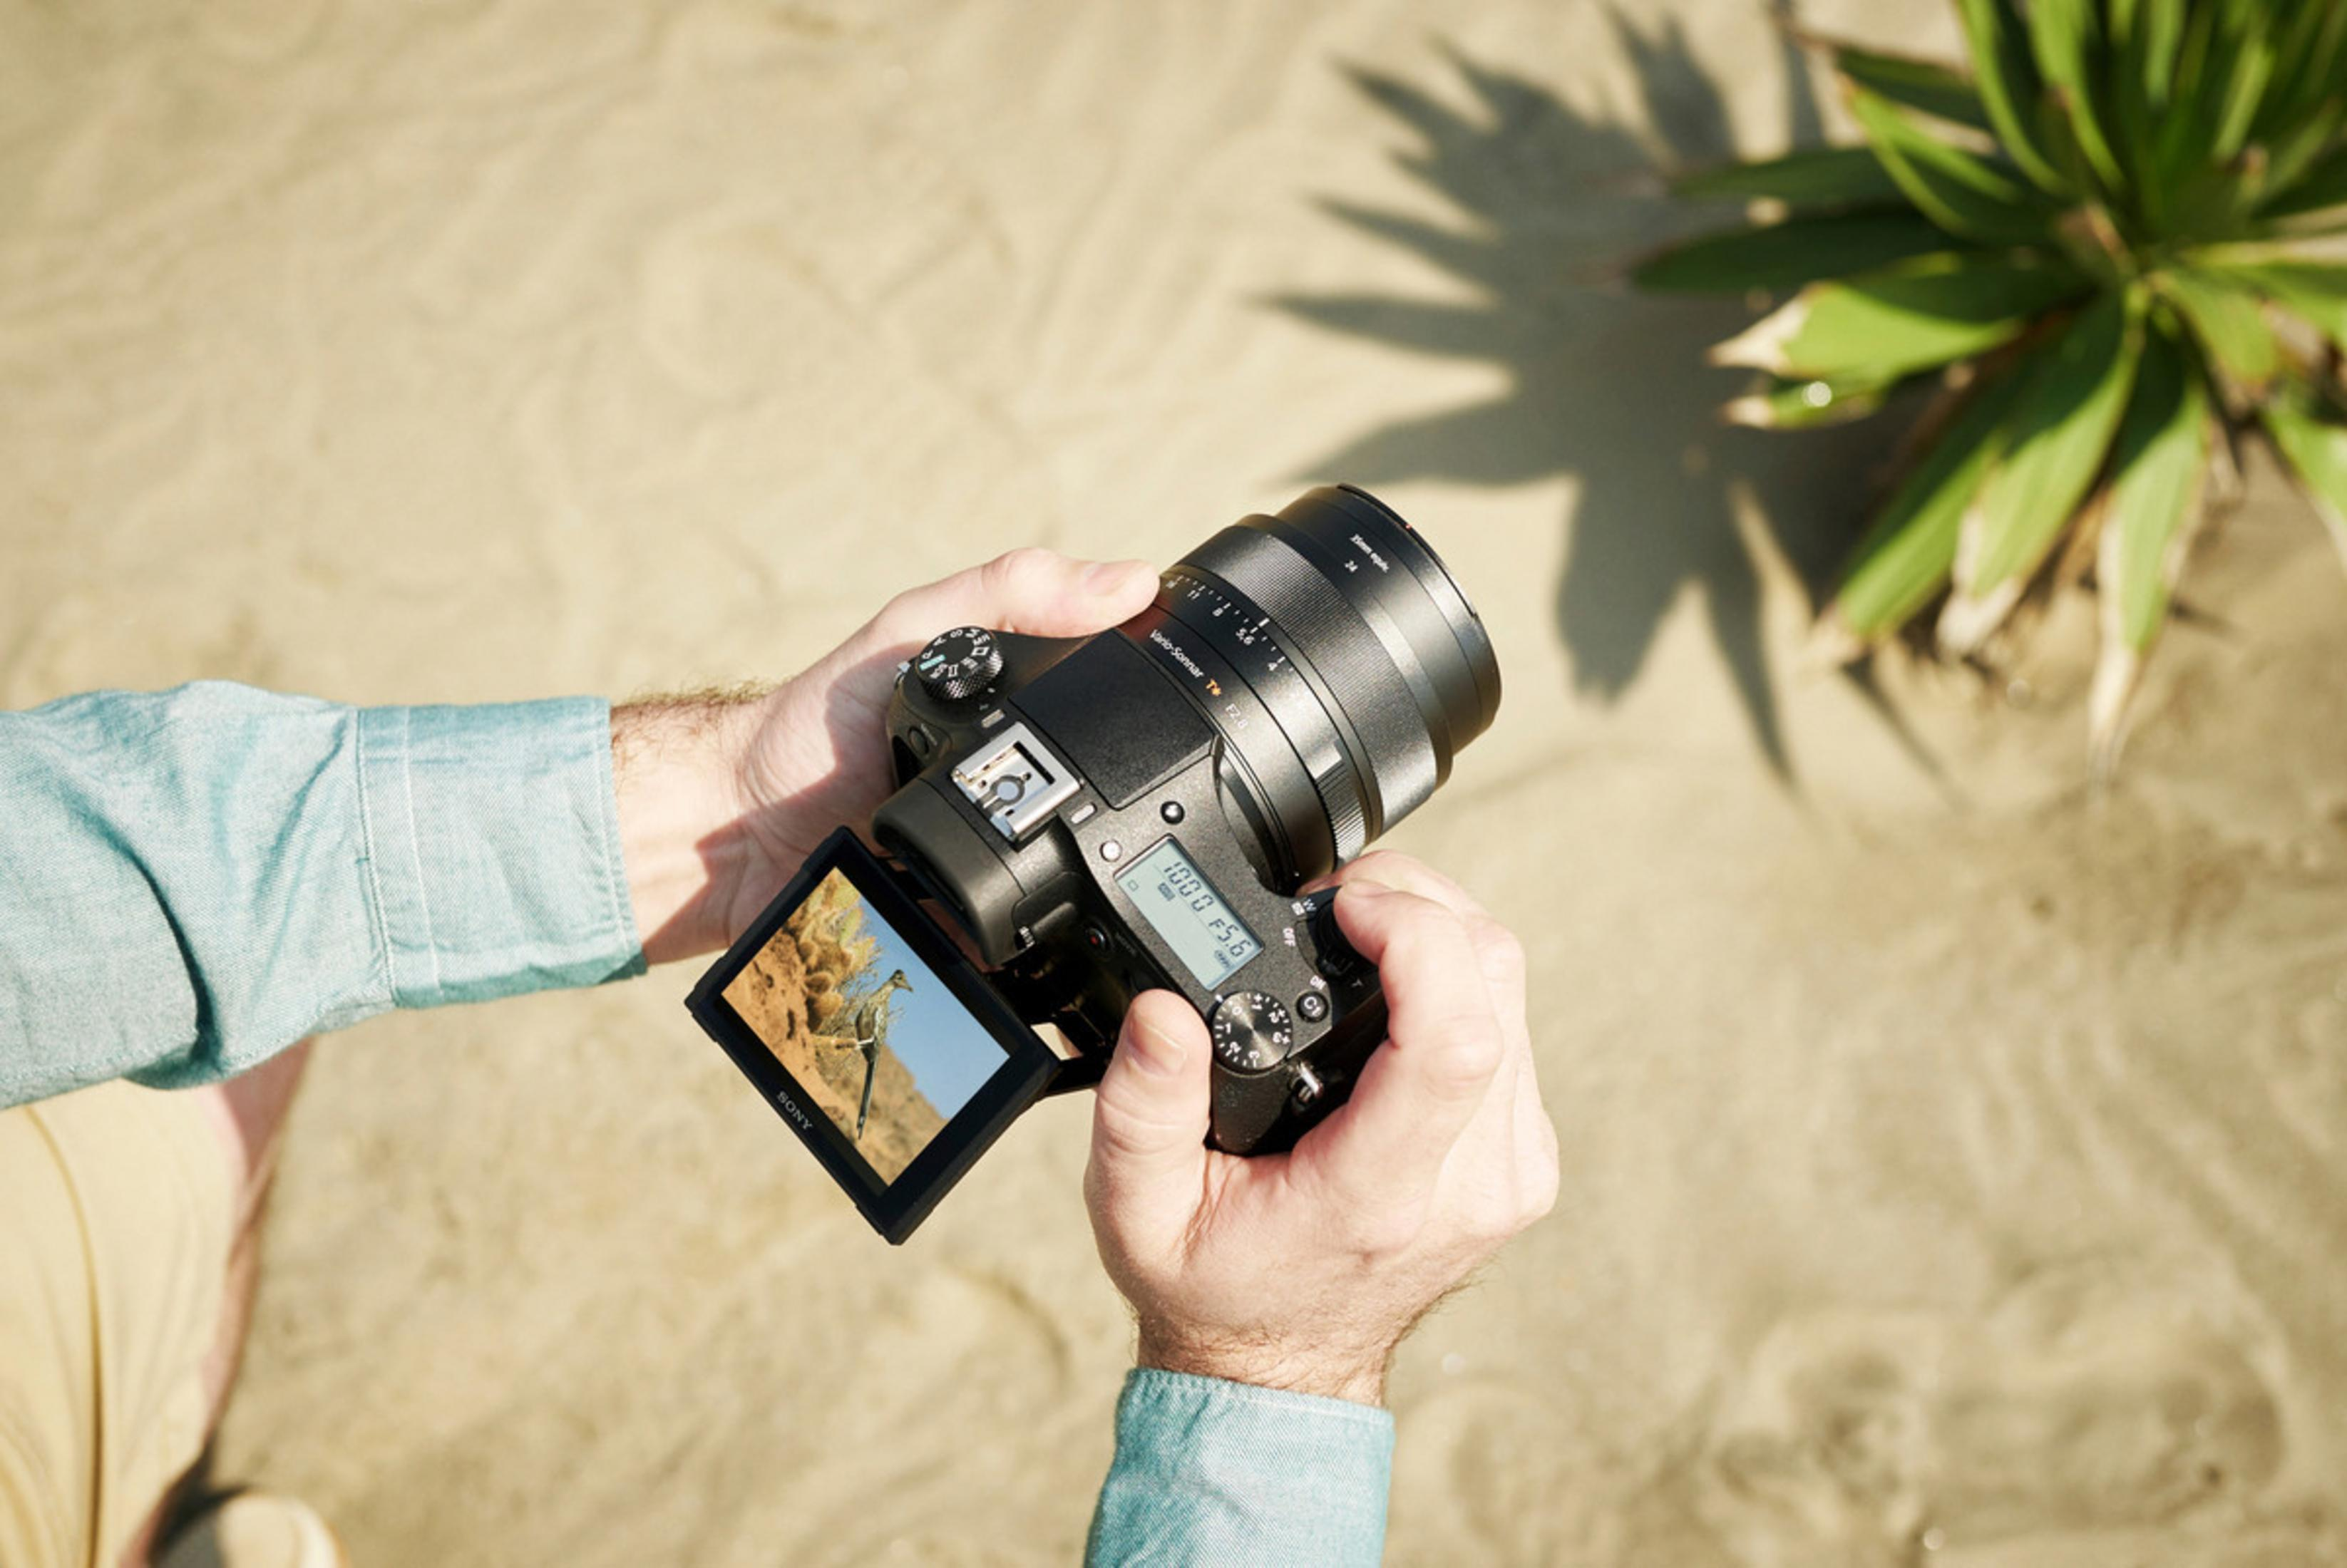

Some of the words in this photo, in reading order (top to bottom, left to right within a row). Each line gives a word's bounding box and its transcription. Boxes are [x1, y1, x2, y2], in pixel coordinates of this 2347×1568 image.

[1187, 590, 1201, 600] 11
[1236, 628, 1255, 645] 5.6
[1268, 662, 1278, 671] 4
[1150, 629, 1204, 678] Vario-Sonnar
[1164, 862, 1214, 912] 1000
[1208, 918, 1251, 957] F5.6
[1283, 927, 1296, 947] OFF
[1303, 996, 1321, 1016] C1
[777, 1091, 813, 1130] SONY
